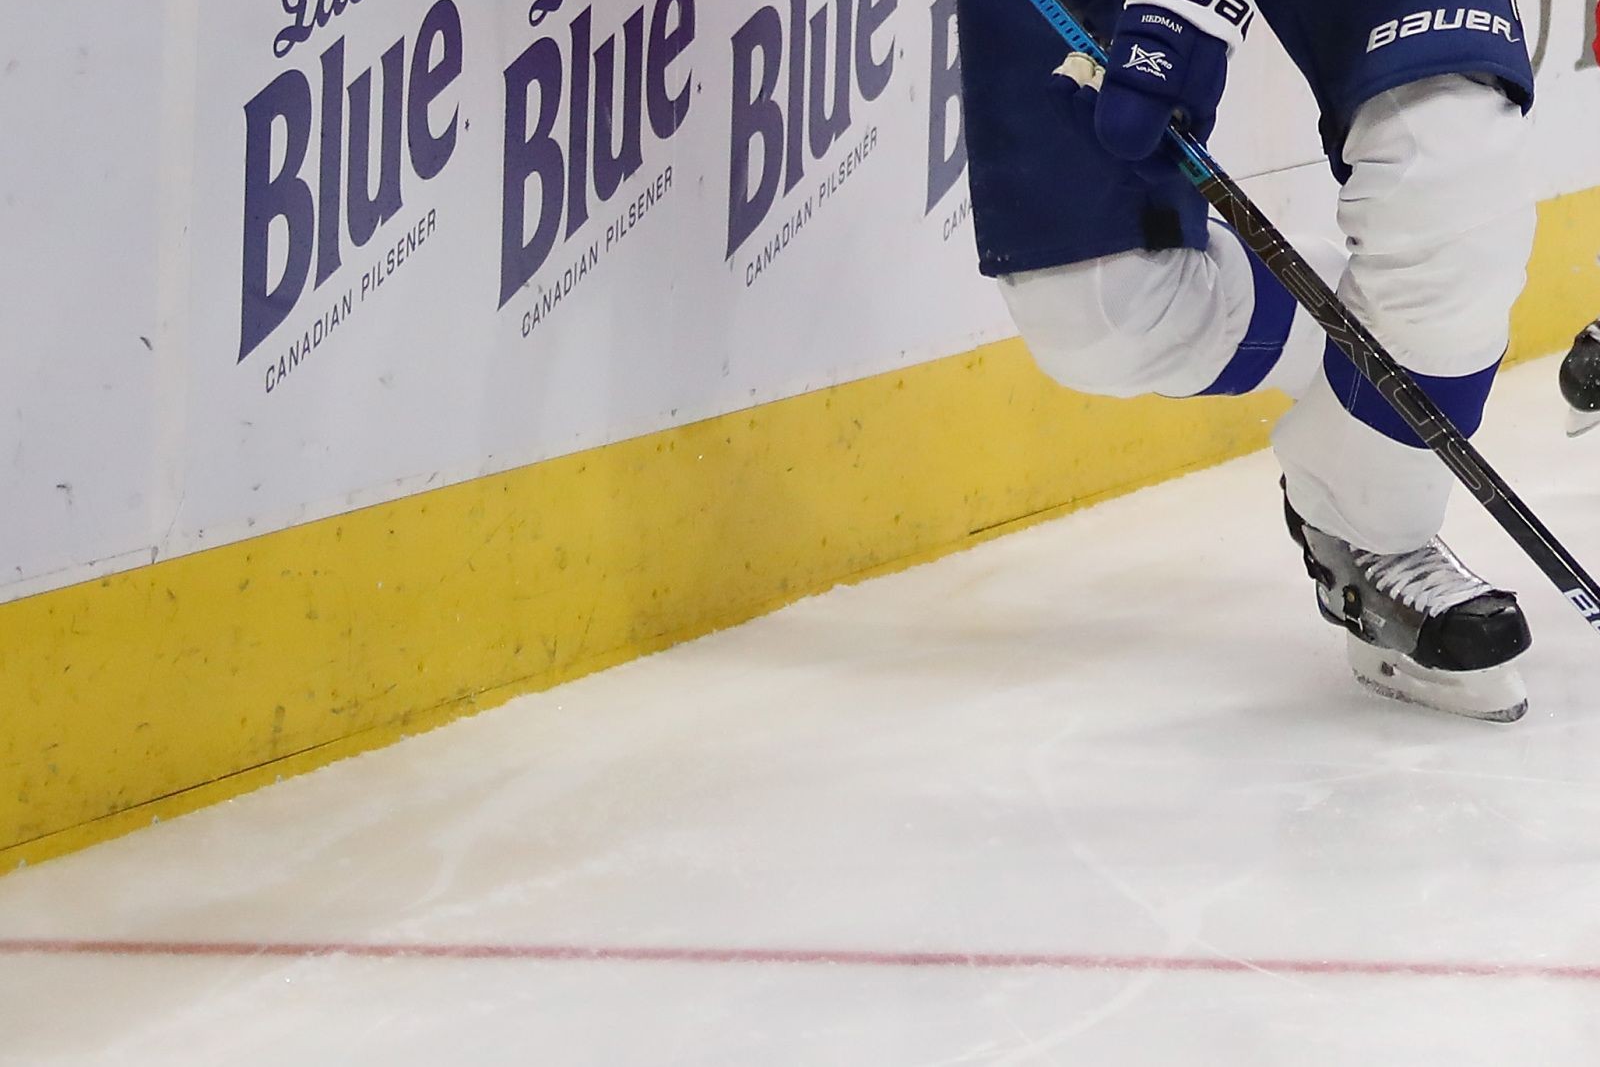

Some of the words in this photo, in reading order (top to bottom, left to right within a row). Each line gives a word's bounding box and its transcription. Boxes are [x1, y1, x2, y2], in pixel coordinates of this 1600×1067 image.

[1141, 15, 1183, 35] HEDMAN
[1156, 58, 1173, 71] PRO
[1366, 7, 1521, 54] BAUER
[521, 240, 599, 338] CANADIAN
[606, 166, 673, 253] PILSENER
[745, 200, 813, 288] CANADIAN
[818, 128, 878, 209] PILSENER
[265, 288, 353, 394] CANADIAN
[361, 208, 437, 303] PILSENER
